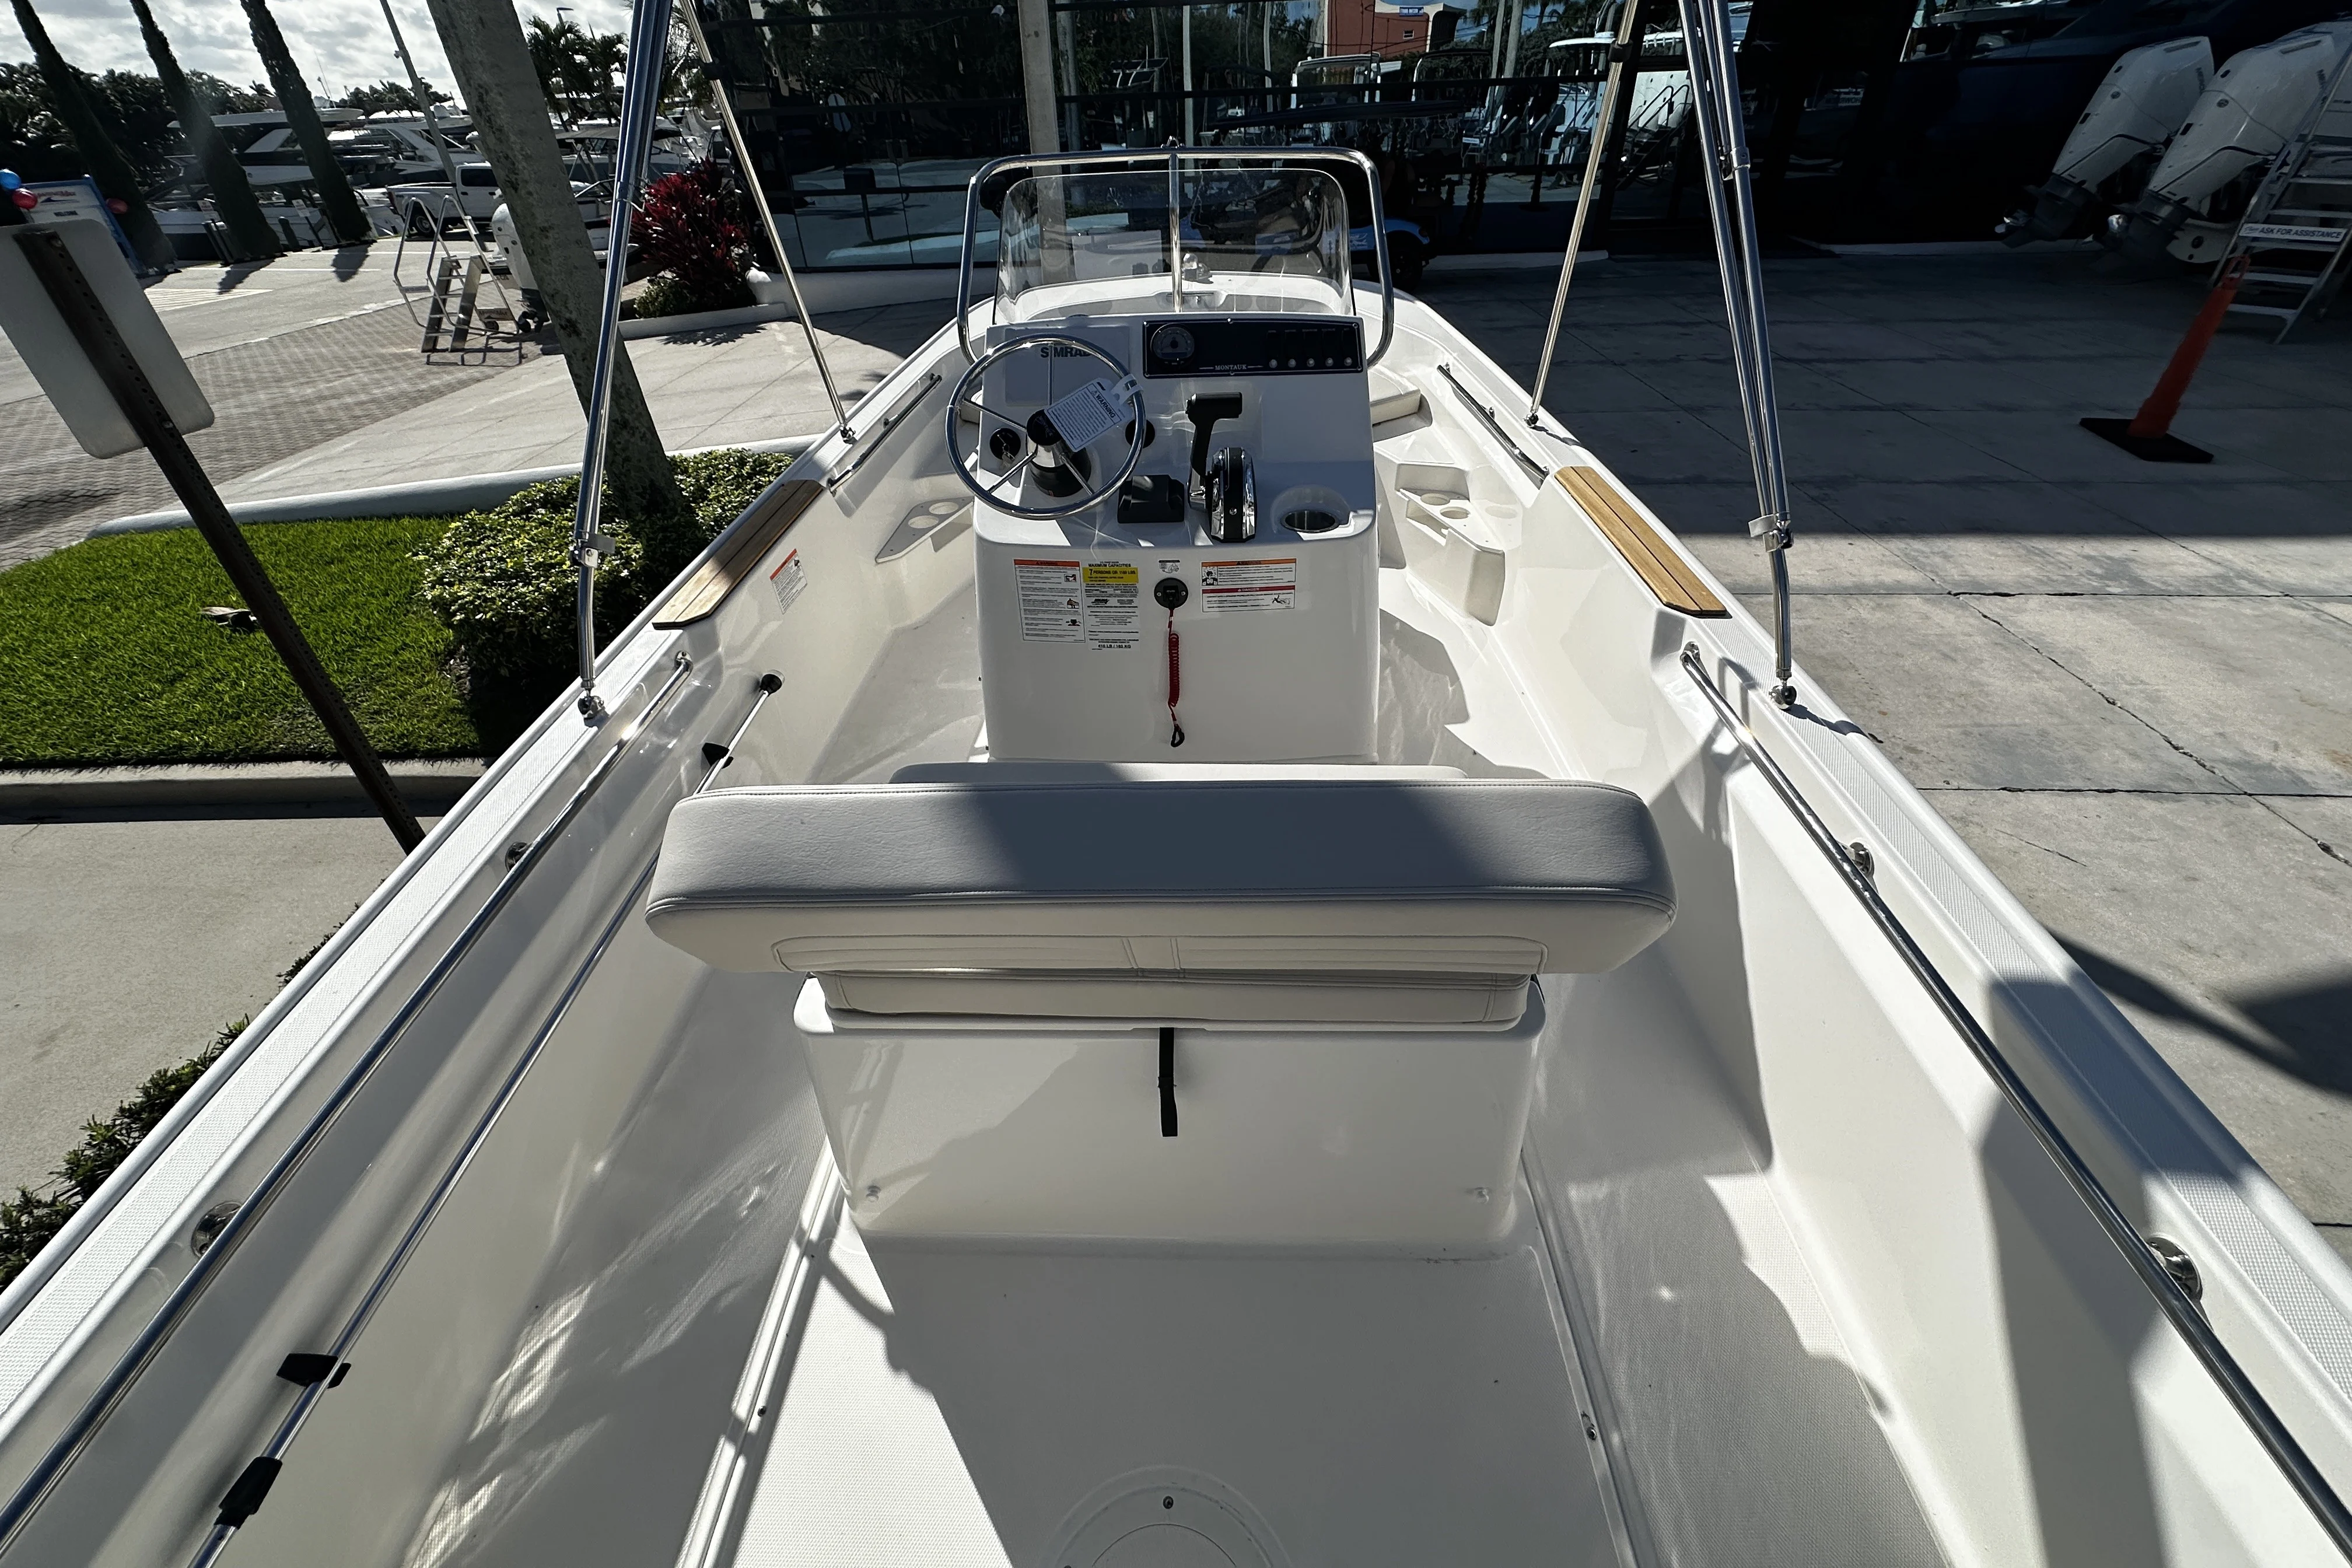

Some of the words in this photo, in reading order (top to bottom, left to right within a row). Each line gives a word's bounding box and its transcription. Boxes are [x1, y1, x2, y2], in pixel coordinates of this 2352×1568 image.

[2293, 230, 2343, 239] ASSISTANCE
[1040, 346, 1091, 358] SMRA
[1096, 394, 1116, 418] WARNING
